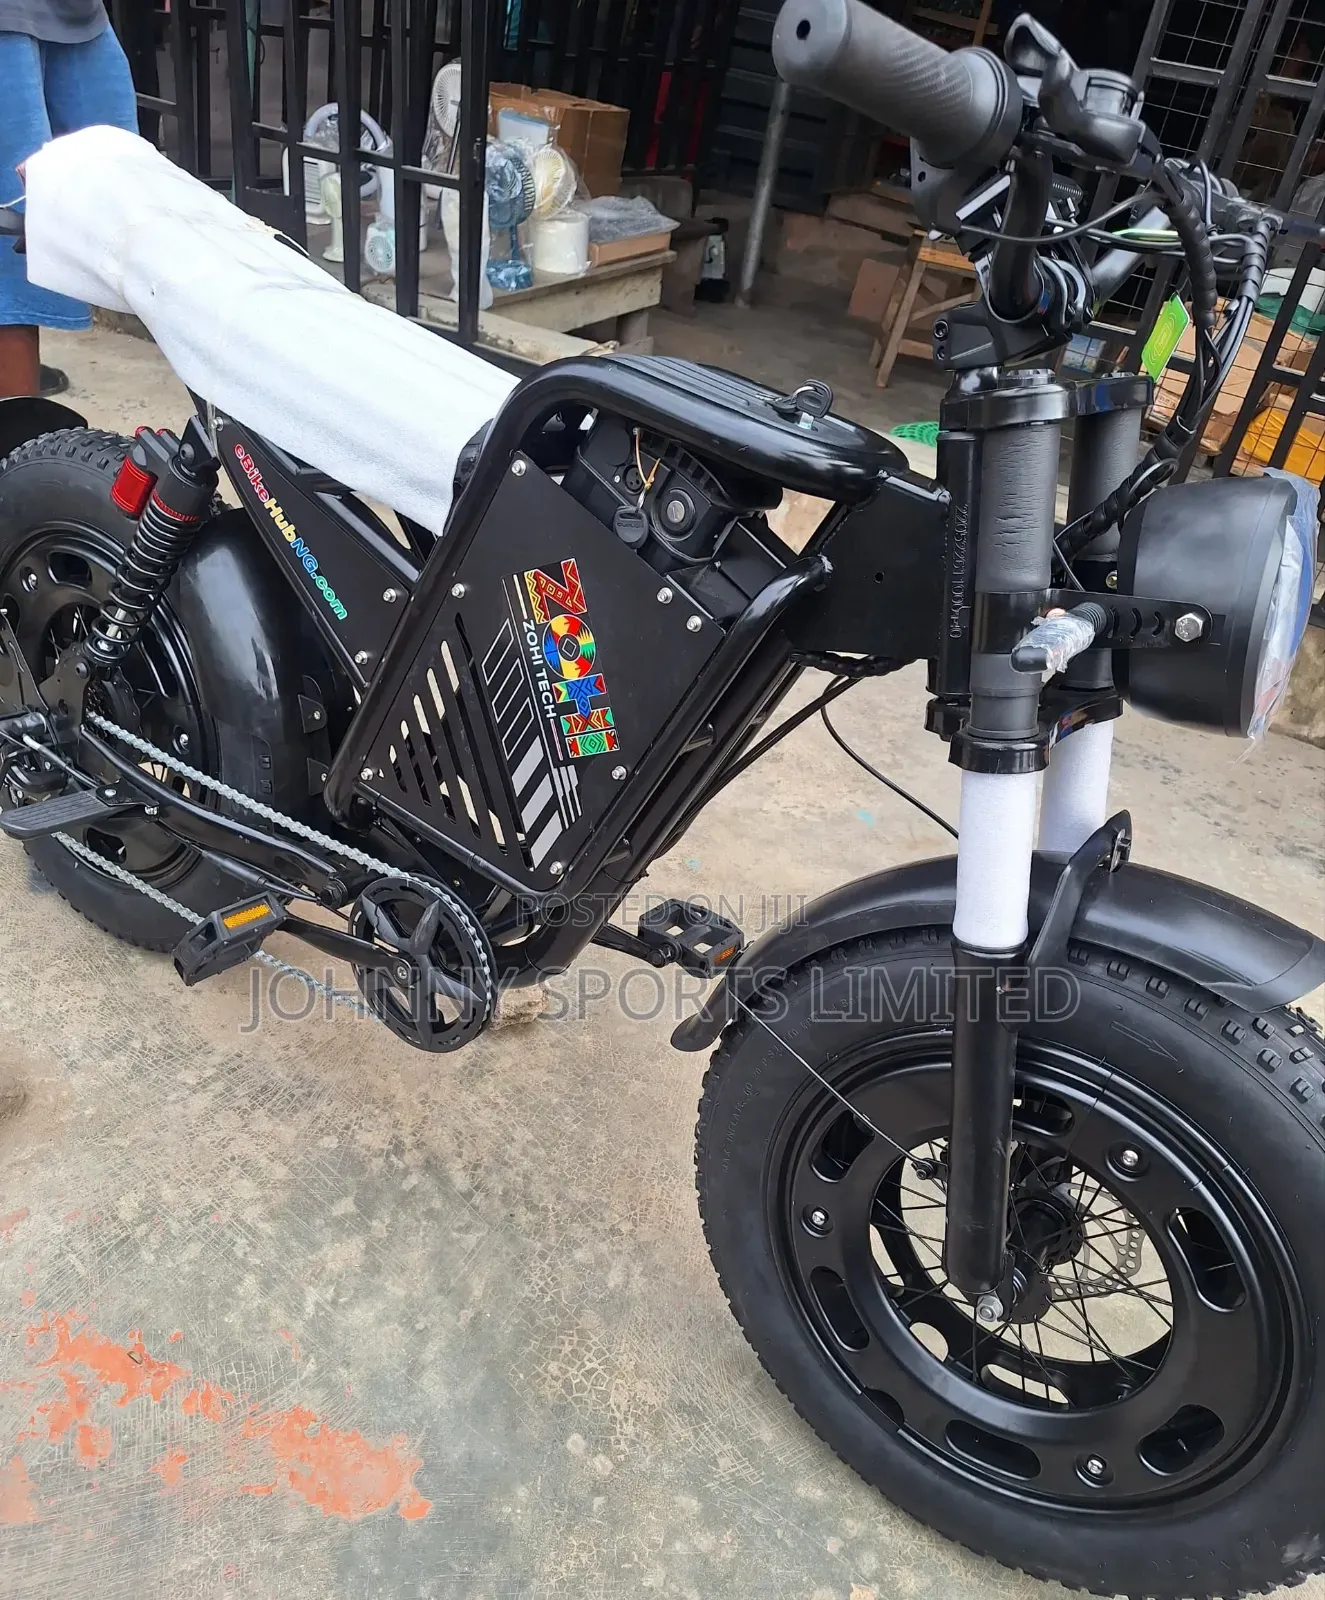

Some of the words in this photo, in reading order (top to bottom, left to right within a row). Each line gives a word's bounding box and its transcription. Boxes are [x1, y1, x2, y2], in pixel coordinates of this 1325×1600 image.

[233, 443, 348, 620] eBikeHubNG.com
[522, 619, 540, 666] ZOHI
[535, 668, 557, 720] TECH
[524, 558, 620, 758] ZOHI
